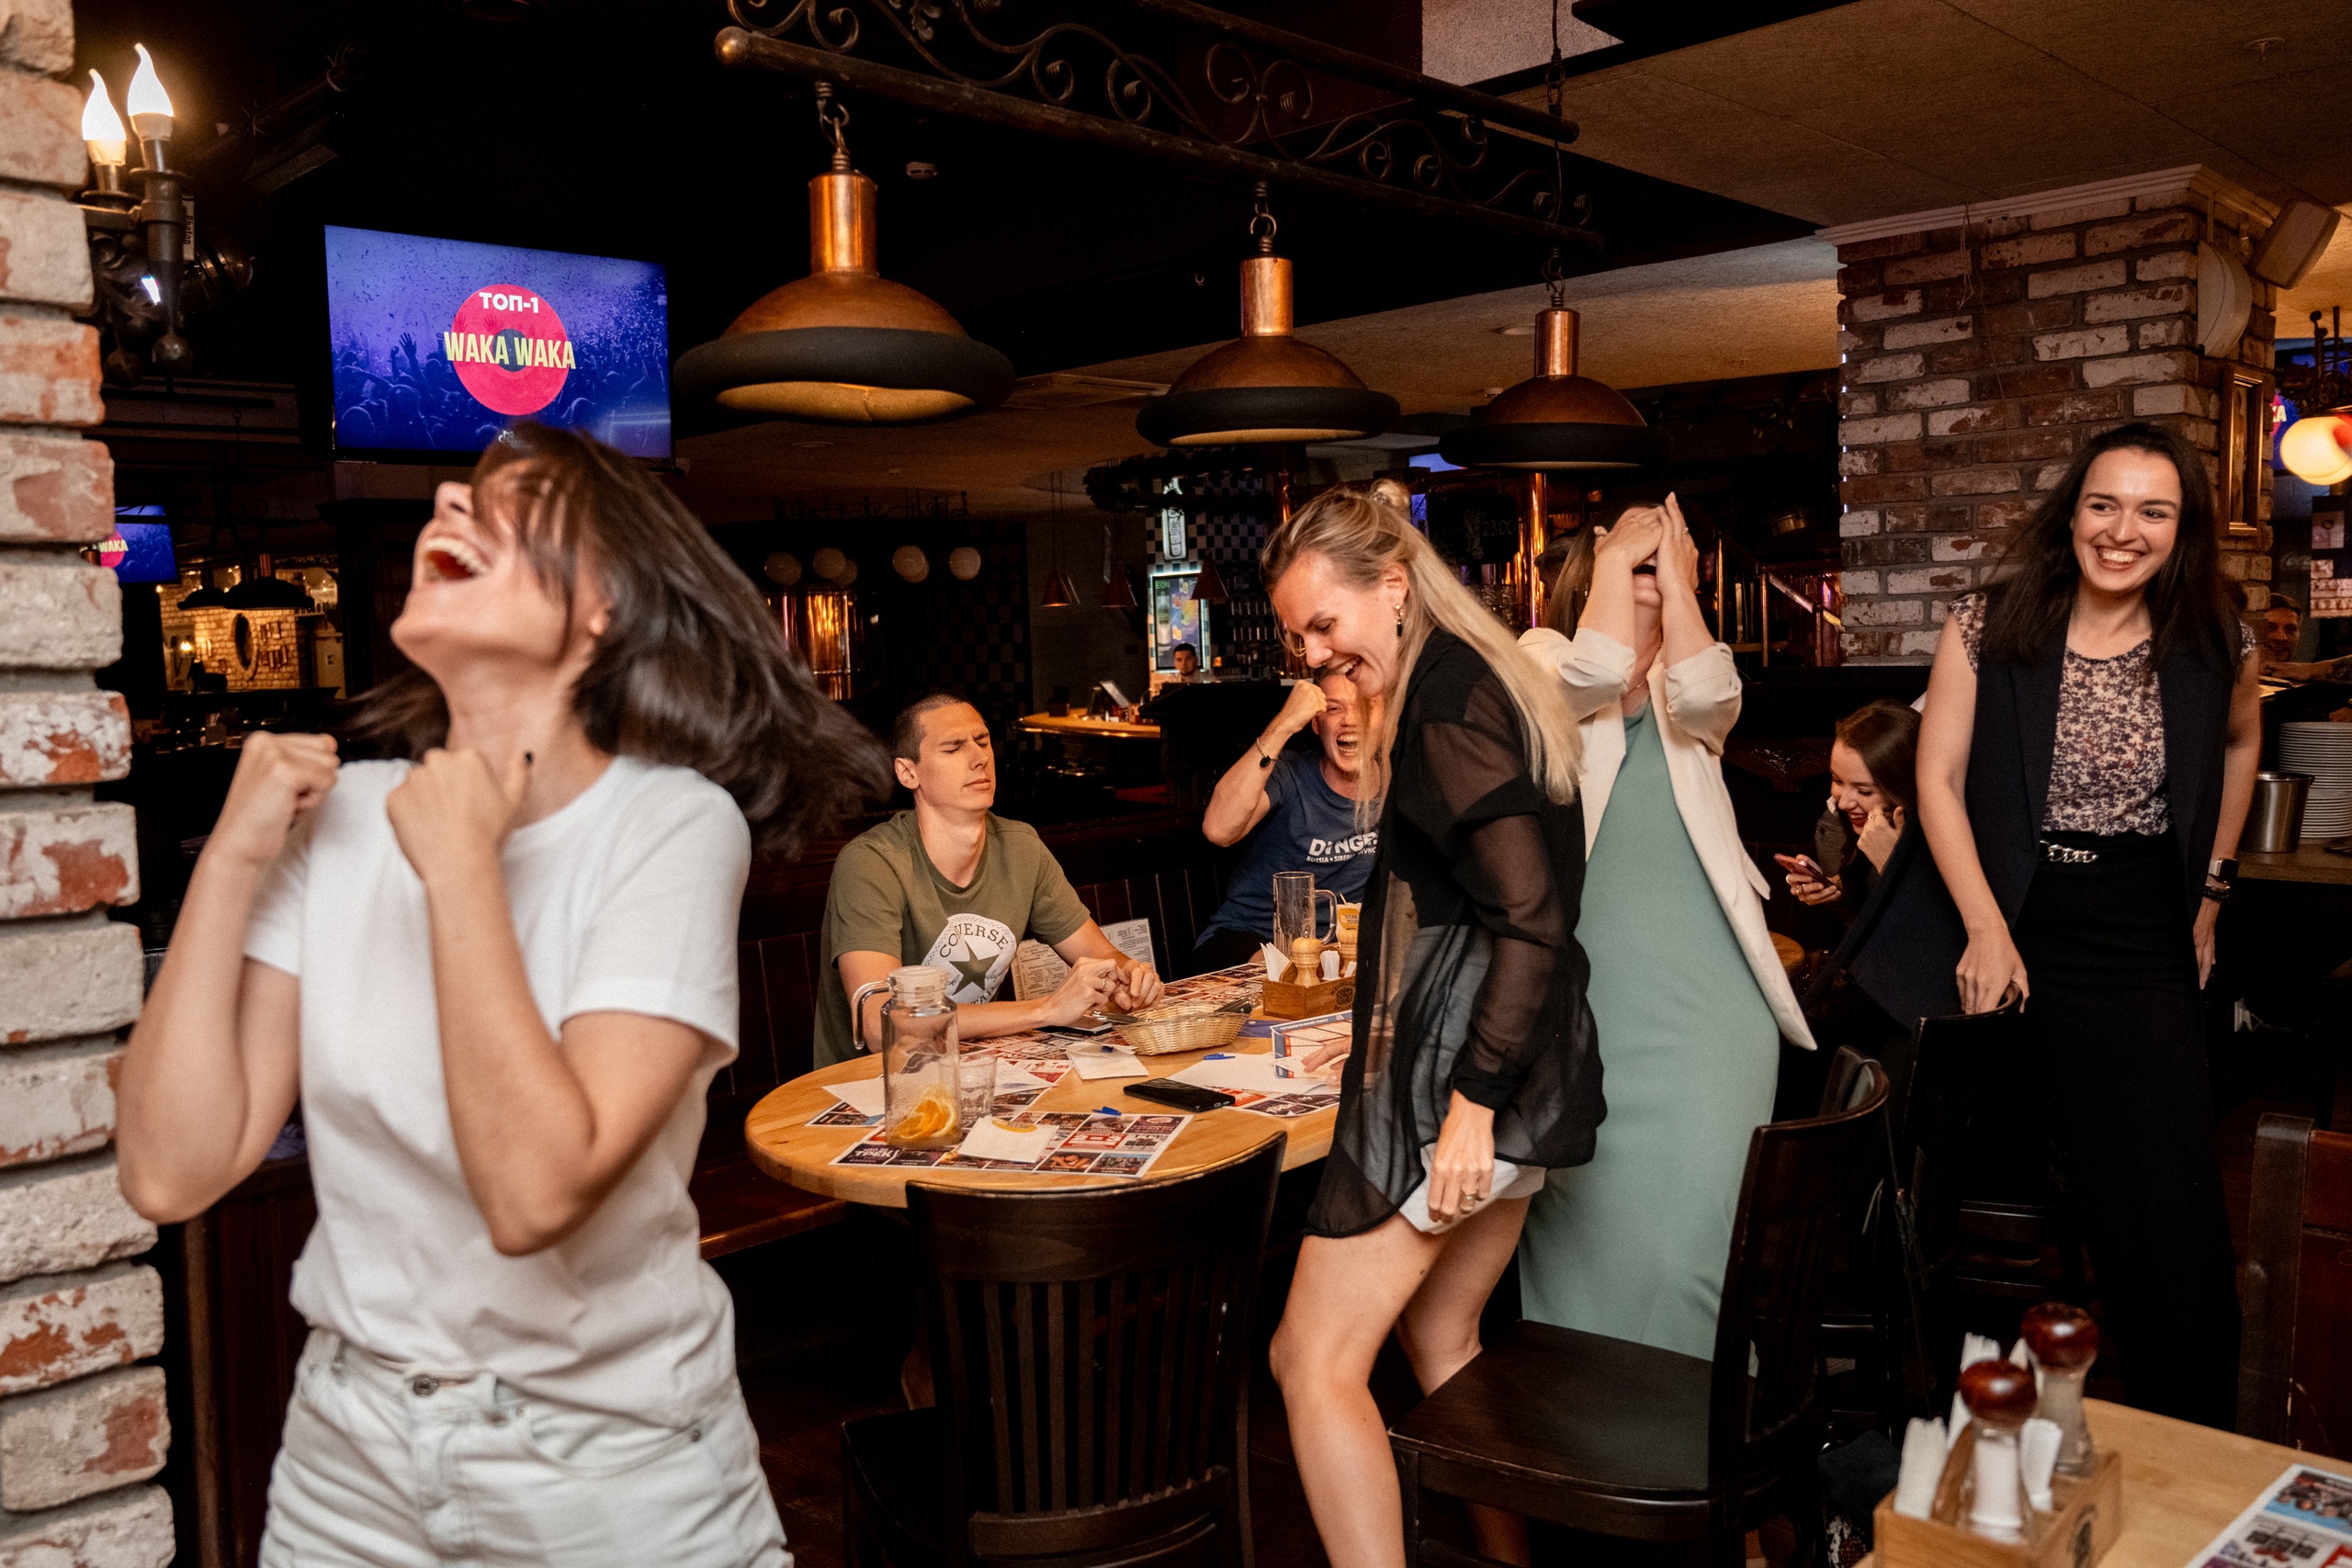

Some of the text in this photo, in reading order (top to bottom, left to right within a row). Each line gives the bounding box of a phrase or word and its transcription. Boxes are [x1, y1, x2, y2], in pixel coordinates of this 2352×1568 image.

[479, 292, 539, 313] ТОП-1
[444, 332, 576, 369] WAKA WAKA
[98, 539, 129, 553] WAKA
